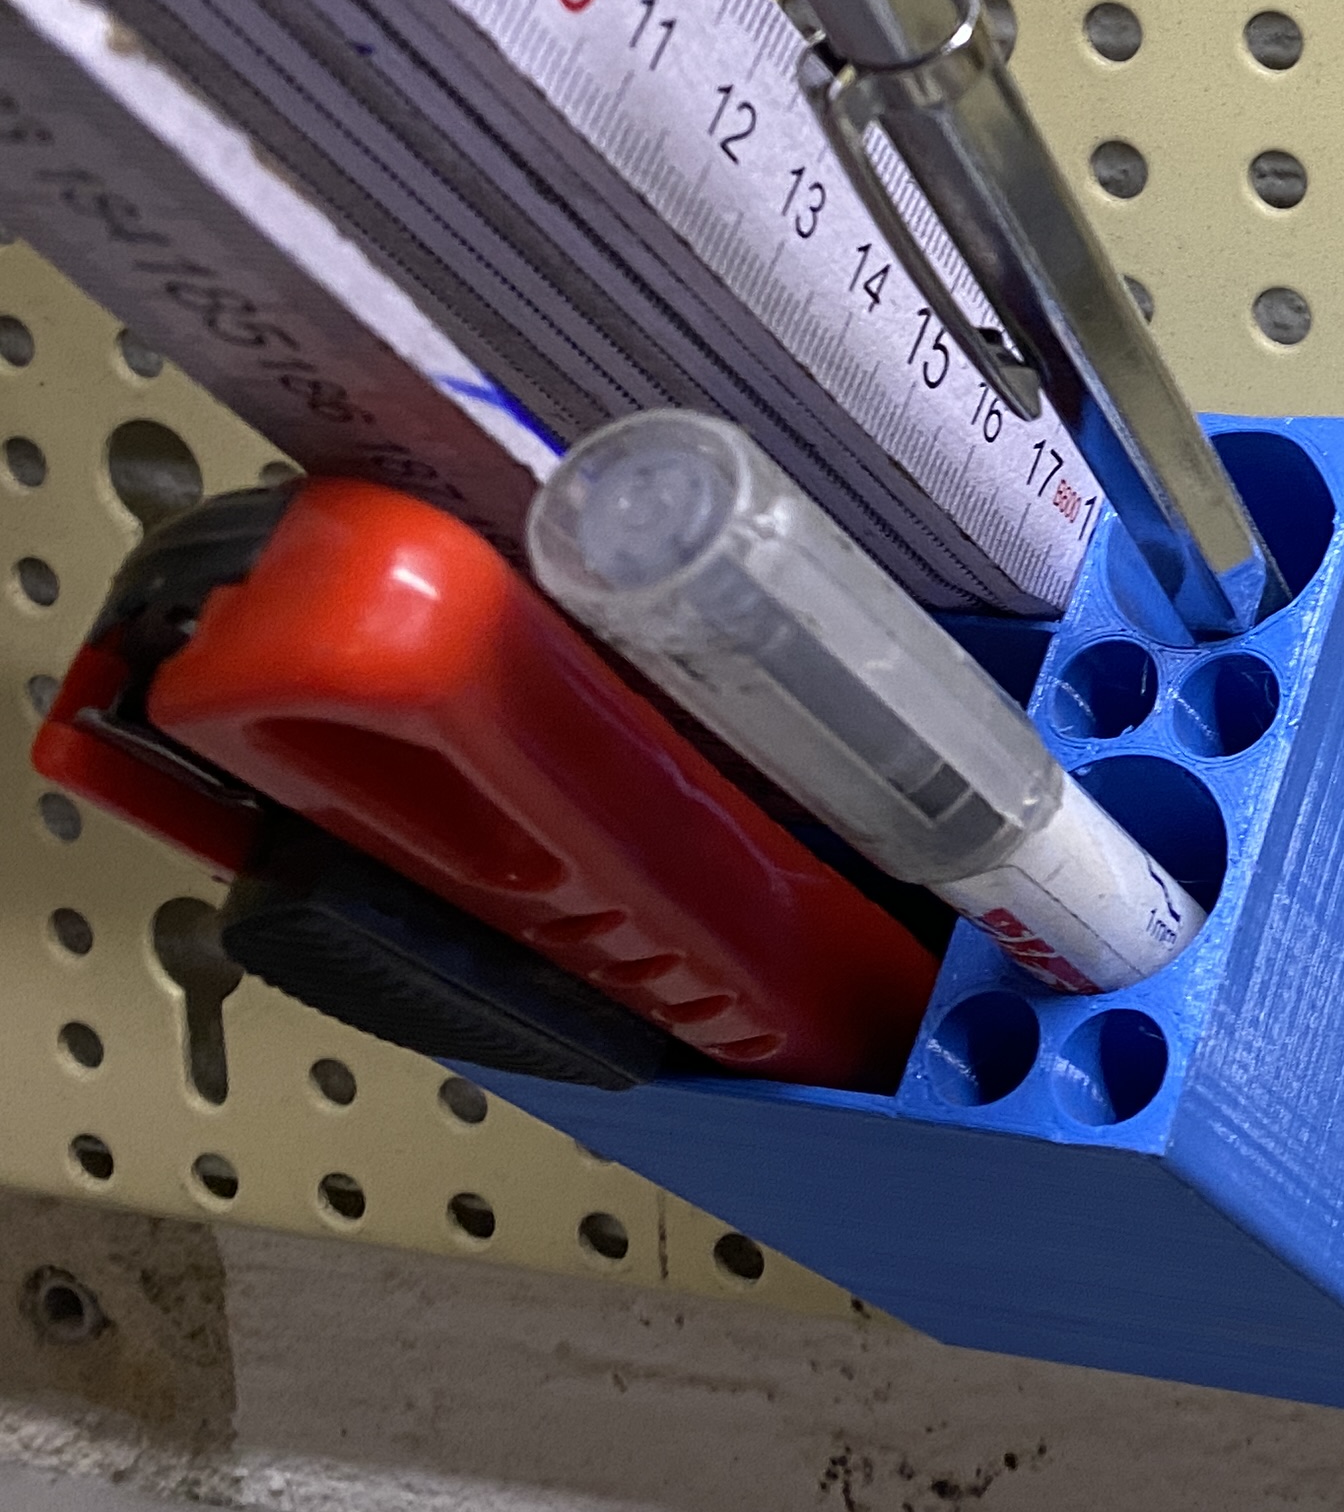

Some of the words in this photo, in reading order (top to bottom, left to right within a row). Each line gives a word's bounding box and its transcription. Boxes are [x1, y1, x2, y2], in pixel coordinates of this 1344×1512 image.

[707, 83, 758, 166] 12
[781, 166, 828, 240] 13
[848, 243, 892, 314] 14
[907, 306, 950, 389] 15
[970, 382, 1003, 444] 16
[1025, 438, 1065, 498] 17
